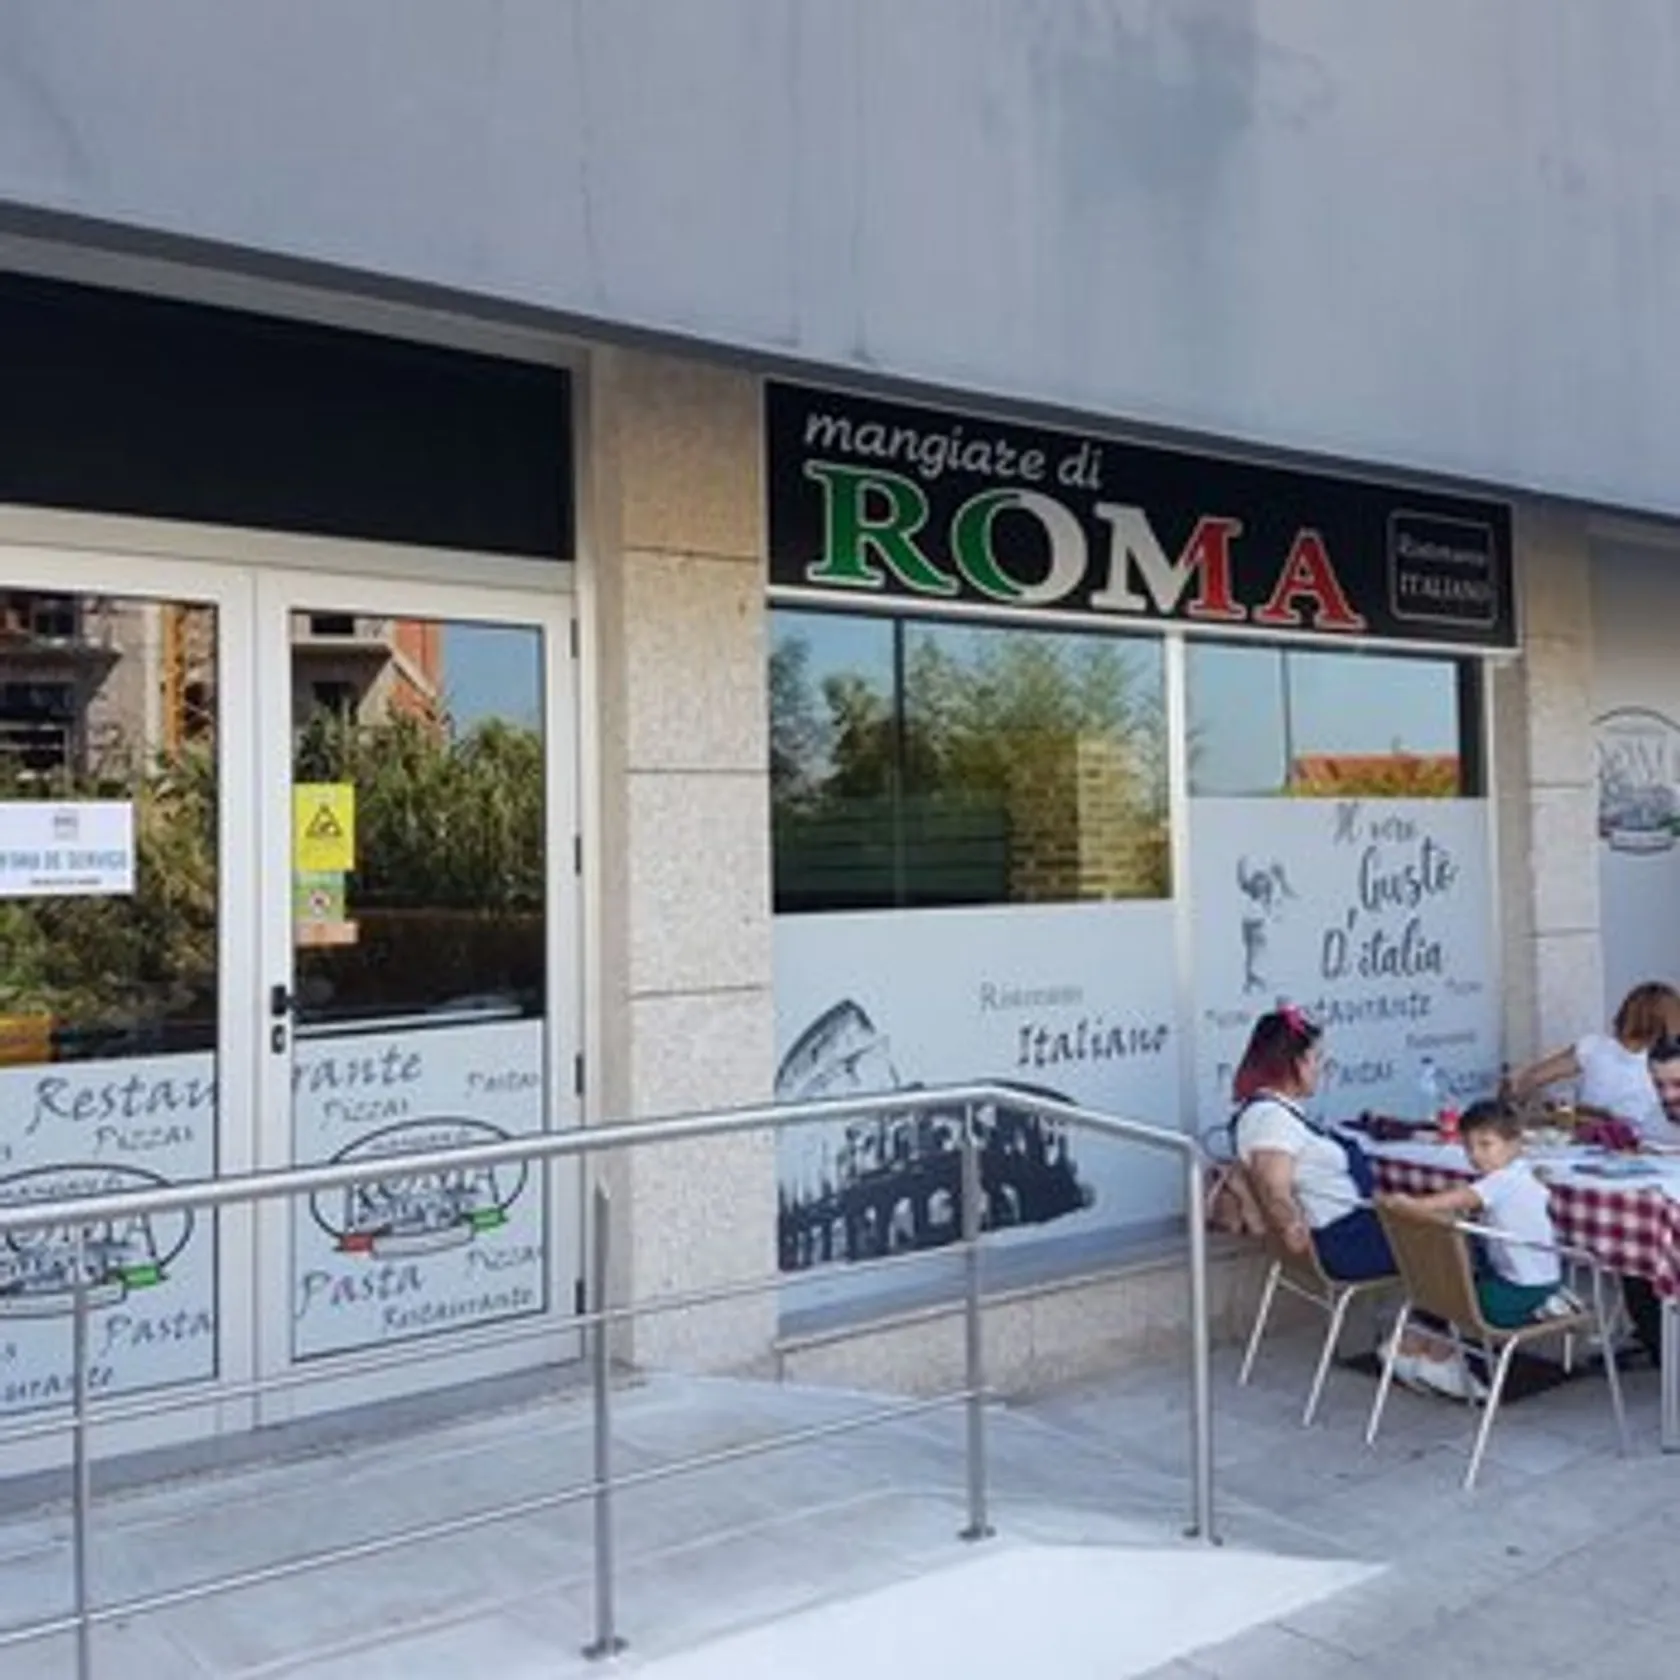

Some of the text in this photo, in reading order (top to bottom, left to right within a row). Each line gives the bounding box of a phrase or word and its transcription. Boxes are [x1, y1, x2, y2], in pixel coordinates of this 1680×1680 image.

[1058, 440, 1103, 491] di
[803, 459, 1367, 632] ROMA
[294, 1265, 425, 1320] Pasta
